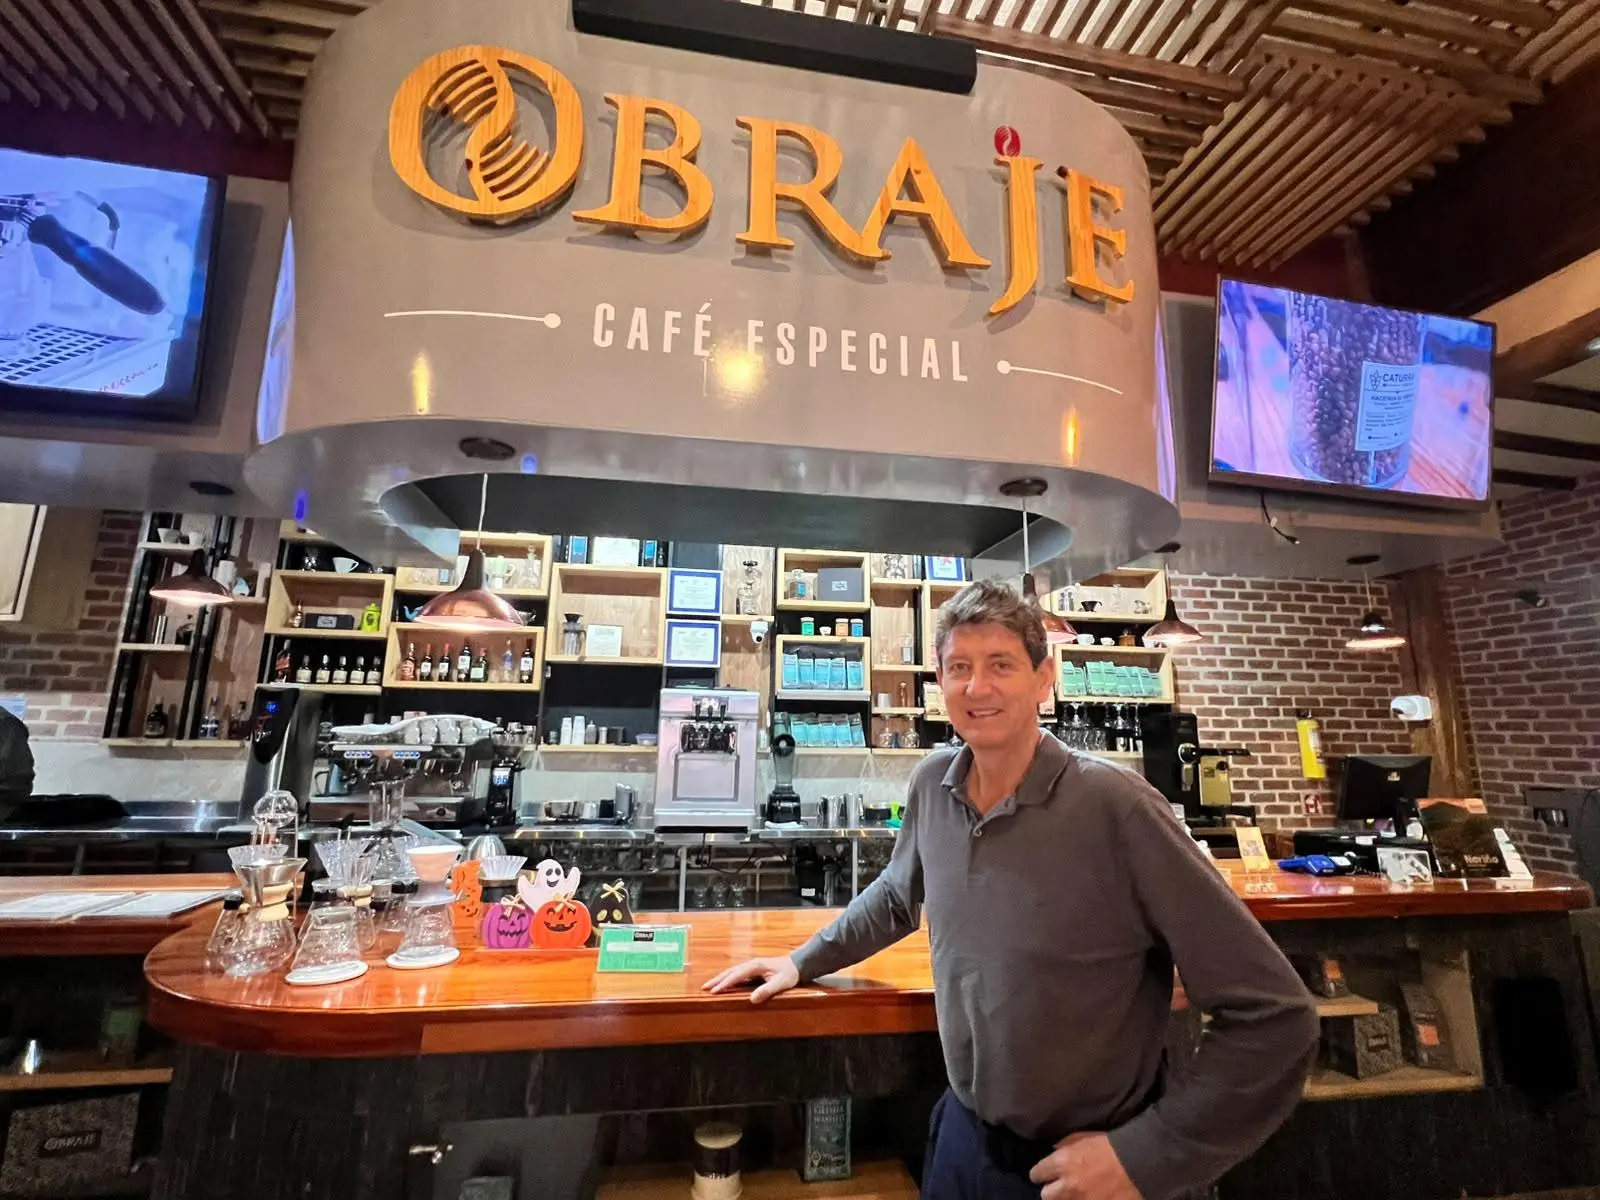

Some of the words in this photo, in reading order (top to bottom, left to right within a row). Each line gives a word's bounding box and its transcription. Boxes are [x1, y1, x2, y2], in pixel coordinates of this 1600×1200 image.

[388, 43, 1135, 316] OBRAJE
[592, 301, 712, 357] CAFÉ
[747, 319, 968, 382] ESPECIAL
